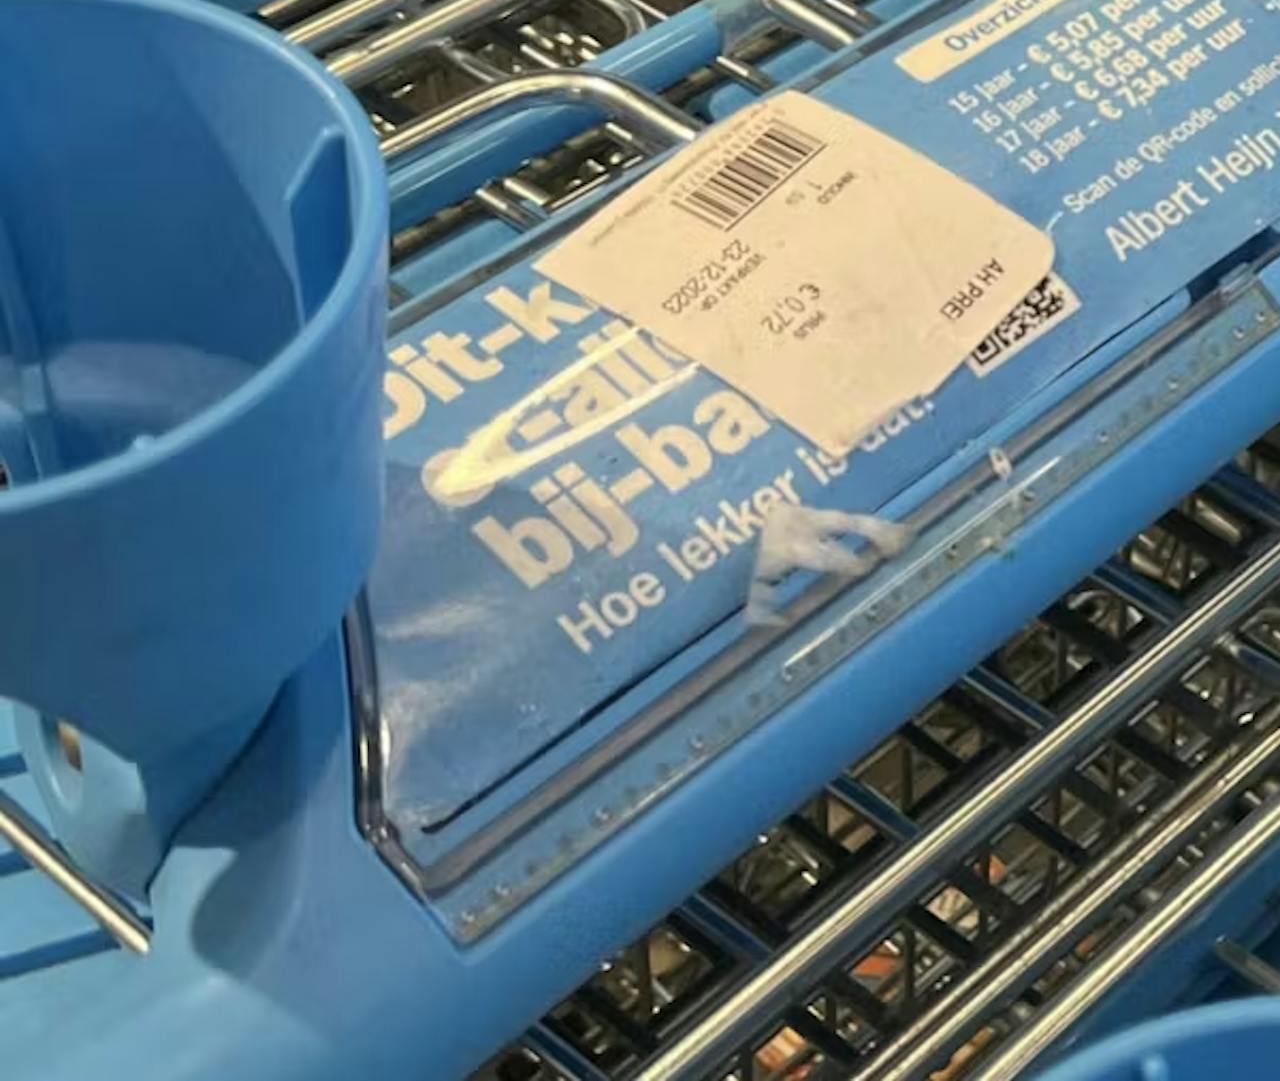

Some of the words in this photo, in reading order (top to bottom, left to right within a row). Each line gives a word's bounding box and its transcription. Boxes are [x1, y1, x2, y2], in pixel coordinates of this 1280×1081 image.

[949, 90, 979, 115] 15
[975, 69, 1017, 102] jaar
[1027, 44, 1052, 64] €
[1046, 12, 1100, 52] 5,07
[973, 109, 1003, 133] 16
[997, 88, 1039, 121] jaar
[1050, 63, 1075, 82] €
[1068, 30, 1124, 71] 5,85
[1123, 7, 1164, 42] per
[996, 129, 1023, 154] 17
[1021, 106, 1063, 141] jaar
[1074, 81, 1099, 101] €
[1094, 49, 1149, 88] 6,68
[1146, 23, 1188, 60] per
[1019, 148, 1050, 174] 18
[1045, 126, 1087, 161] jaar
[1097, 99, 1123, 120] €
[1116, 69, 1169, 108] 7,34
[1166, 44, 1208, 80] per
[1206, 18, 1247, 51] uur
[1063, 174, 1117, 215] Scan
[1114, 153, 1144, 181] de
[1139, 104, 1219, 163] QR-code
[1215, 91, 1242, 113] en
[973, 255, 1003, 283] AH
[1104, 181, 1209, 262] Albert
[662, 239, 750, 314] 23-12-2023
[761, 296, 806, 336] 0,72
[799, 283, 821, 300] €
[557, 572, 666, 654] Hoe
[656, 469, 801, 581] lekker
[796, 444, 849, 486] is
